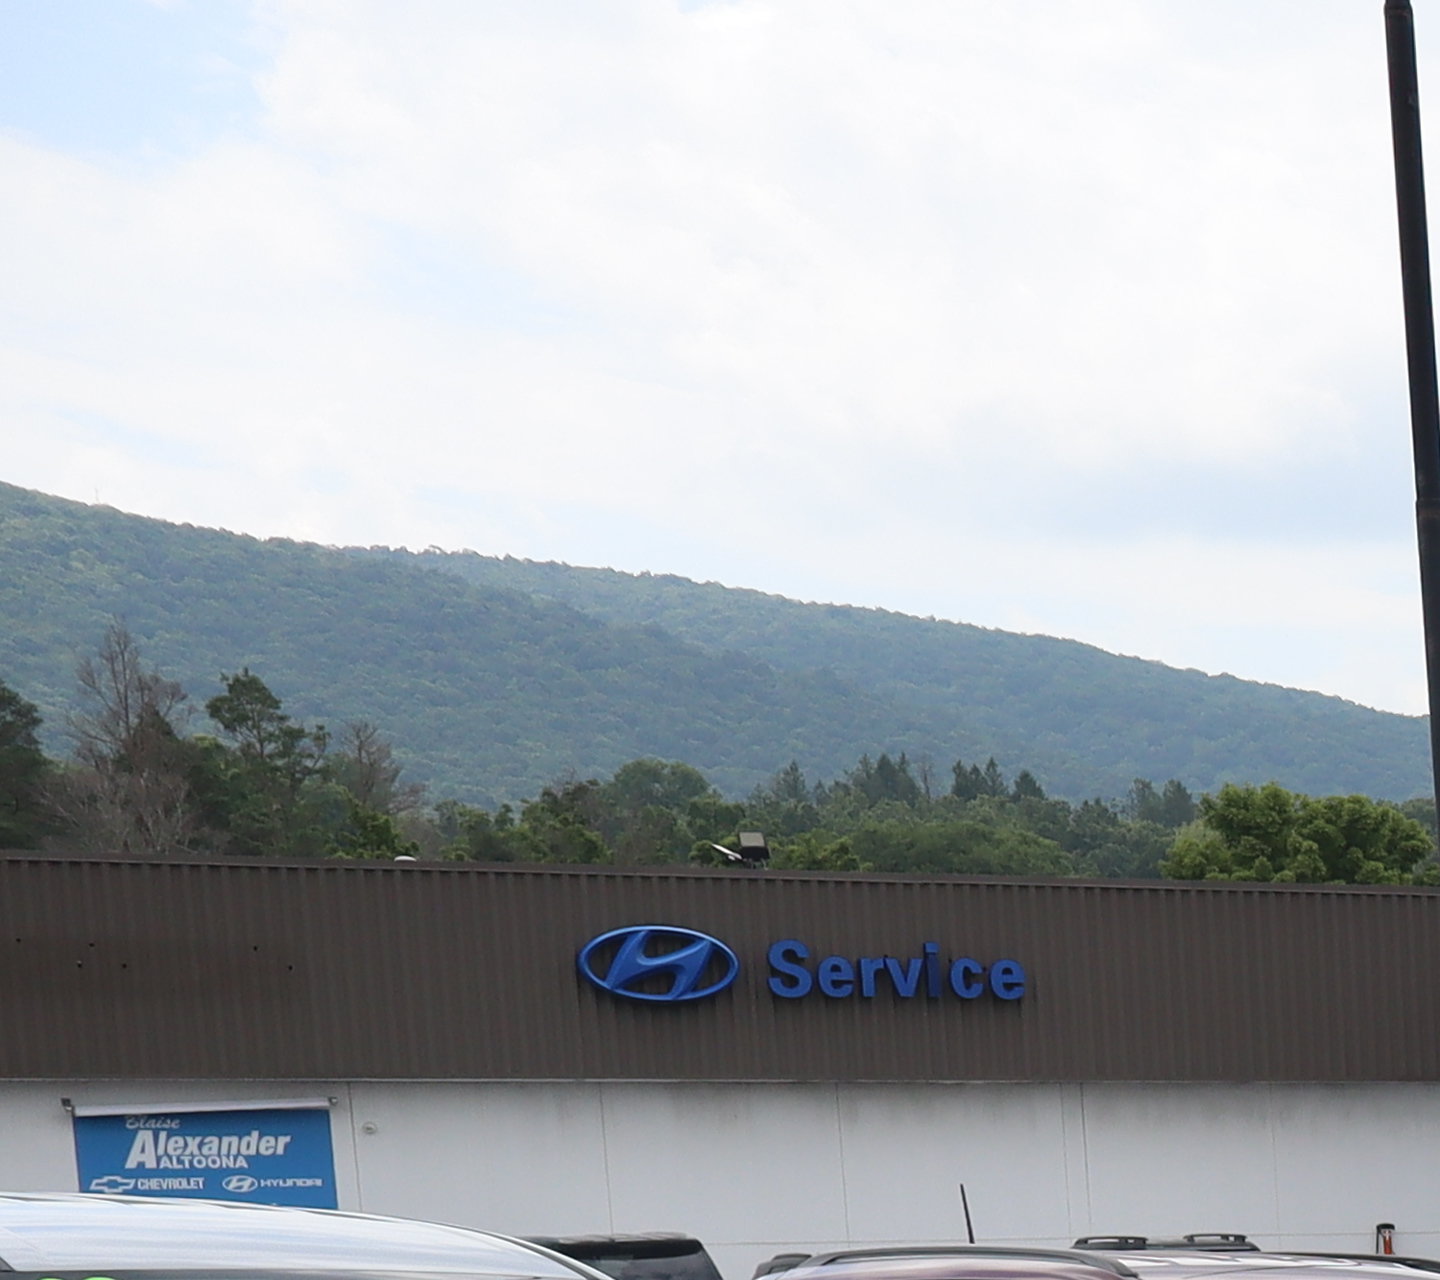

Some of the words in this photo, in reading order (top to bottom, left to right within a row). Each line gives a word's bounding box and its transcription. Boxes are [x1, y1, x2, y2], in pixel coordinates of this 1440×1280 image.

[766, 938, 1026, 1000] Service
[125, 1130, 291, 1169] Alexander
[159, 1155, 248, 1169] ALTOONA
[137, 1177, 205, 1190] CHEVROLET
[260, 1178, 322, 1188] HYUNDAI
